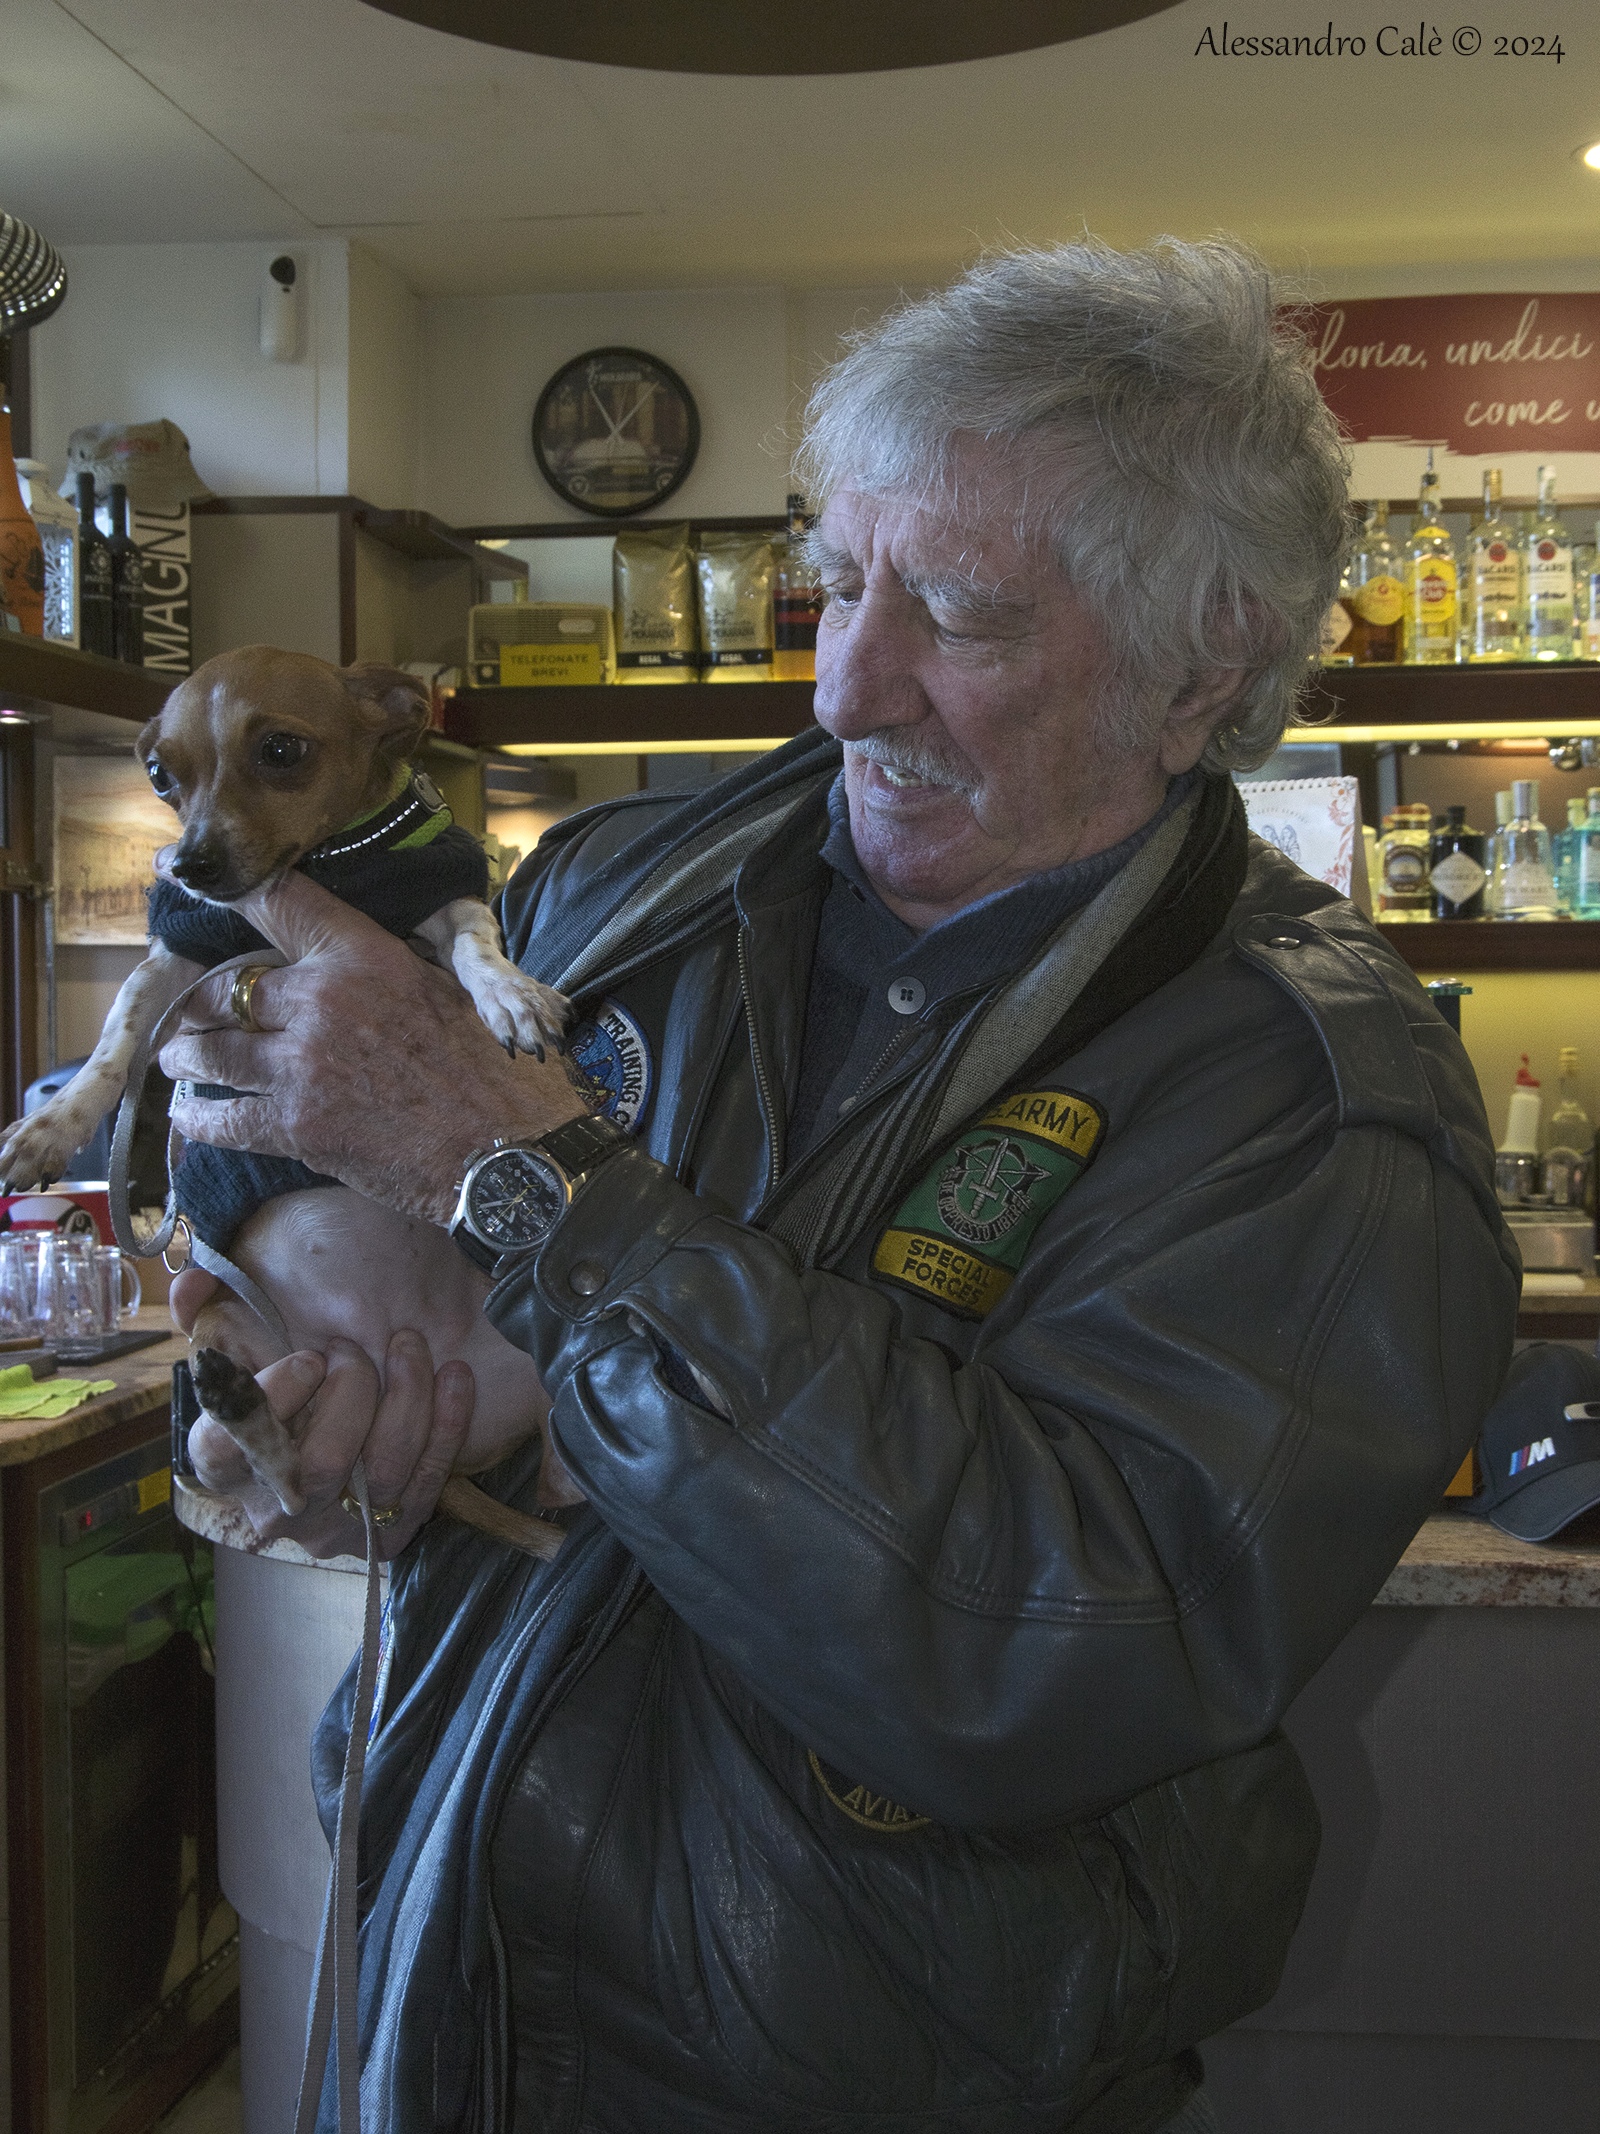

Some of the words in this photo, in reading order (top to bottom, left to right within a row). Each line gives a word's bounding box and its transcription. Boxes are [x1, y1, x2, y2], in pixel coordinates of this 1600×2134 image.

[1305, 308, 1429, 371] loria,
[1444, 298, 1596, 367] undici
[1463, 399, 1575, 428] come
[510, 653, 589, 665] TELEFONATE
[606, 1012, 643, 1105] TRAINING
[901, 1256, 984, 1306] FORCES
[907, 1238, 990, 1288] SPECIAL
[1526, 1436, 1557, 1468] M
[842, 1784, 921, 1824] AVIA
